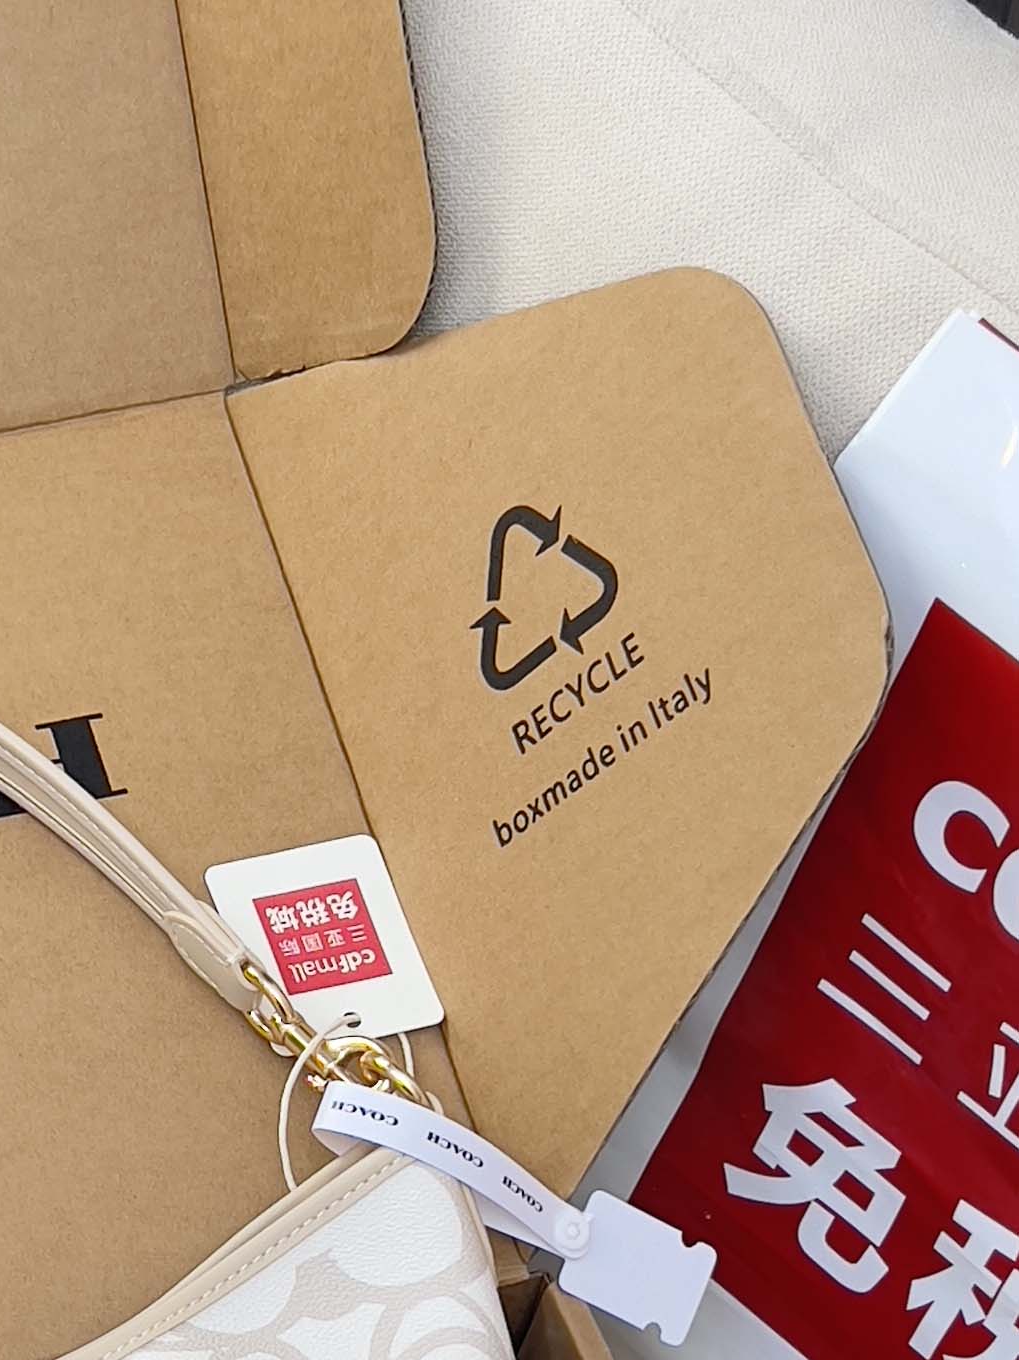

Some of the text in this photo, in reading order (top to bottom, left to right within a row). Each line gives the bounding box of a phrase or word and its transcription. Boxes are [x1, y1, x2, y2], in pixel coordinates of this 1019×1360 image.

[511, 632, 645, 754] RECYCLE
[492, 667, 714, 848] boxmade in Italy
[265, 890, 359, 933] 免税城
[913, 780, 1019, 942] c
[278, 924, 367, 957] 三亚国际
[288, 949, 376, 983] cdfmall
[331, 1100, 544, 1214] COACH COACH COACH
